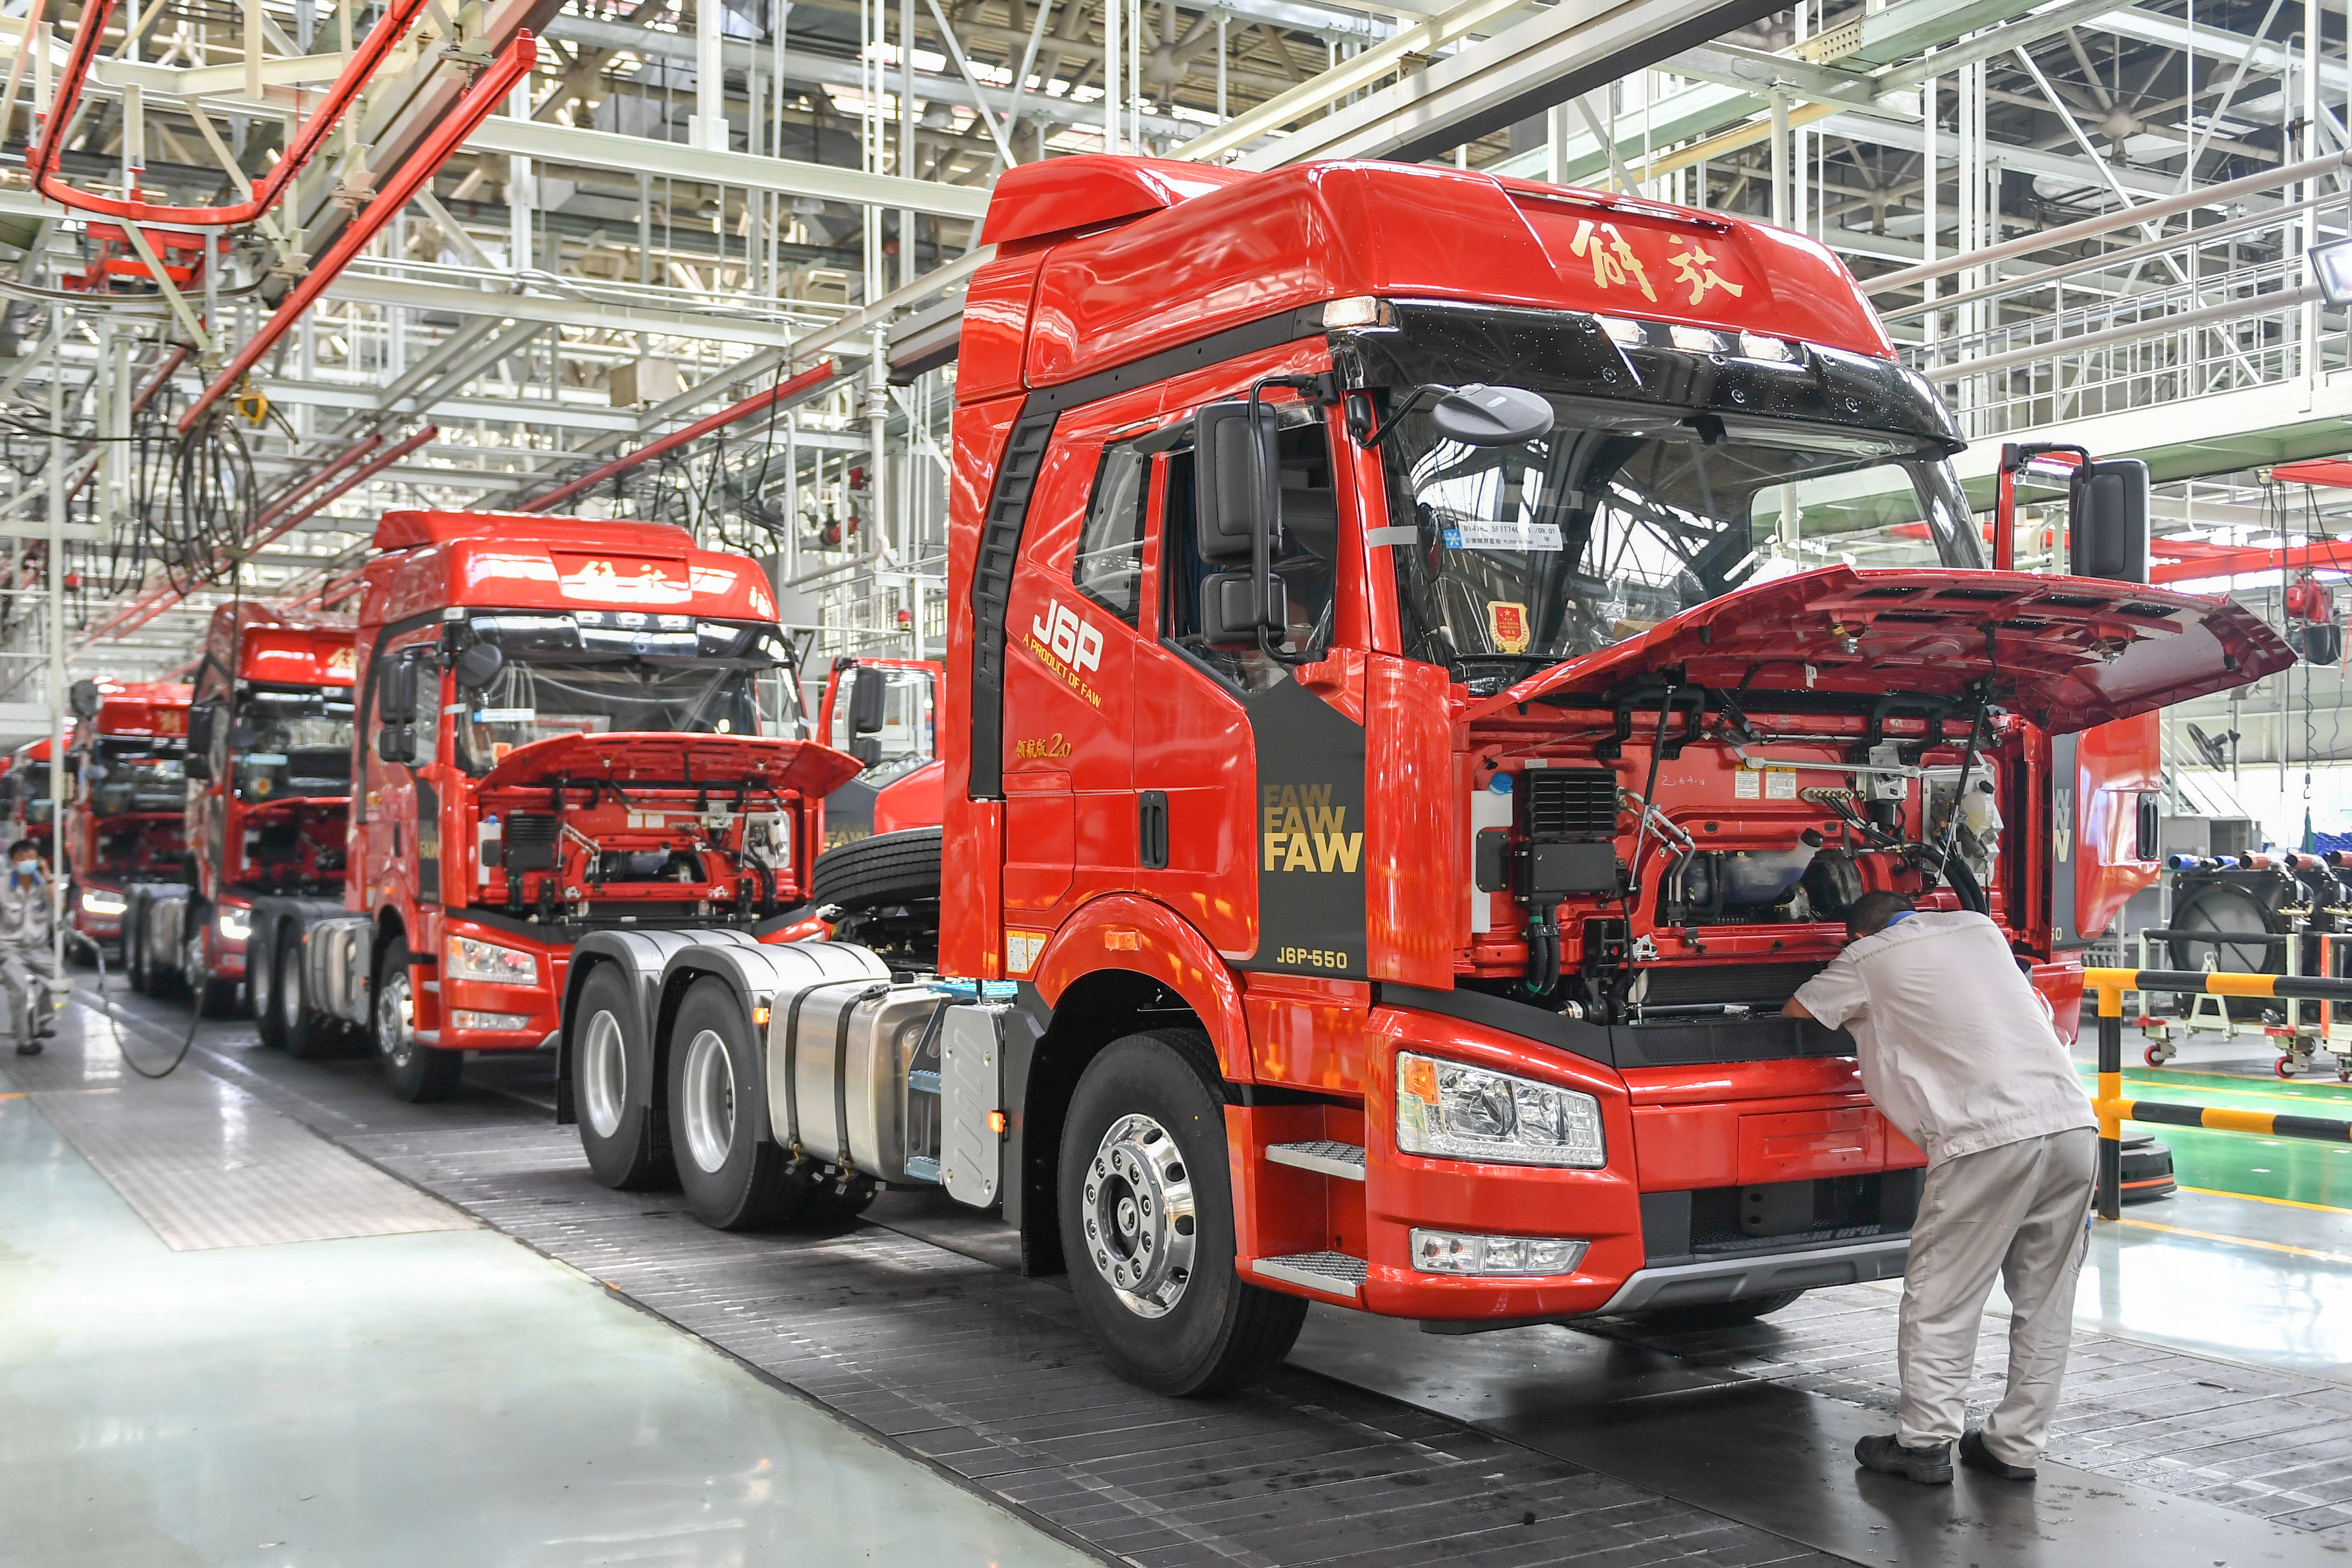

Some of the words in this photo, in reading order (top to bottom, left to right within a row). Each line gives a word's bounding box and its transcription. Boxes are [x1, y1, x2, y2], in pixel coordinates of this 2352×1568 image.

[1032, 598, 1104, 672] J6P
[1022, 633, 1029, 646] A
[1030, 638, 1068, 679] PRODUCT
[1068, 672, 1081, 689] OF
[1081, 682, 1101, 708] FAW
[1048, 732, 1071, 758] 2.0
[1264, 784, 1332, 814] FAW
[1264, 805, 1346, 840] FAW
[1264, 832, 1364, 873] FAW
[1276, 946, 1348, 969] J6P-550
